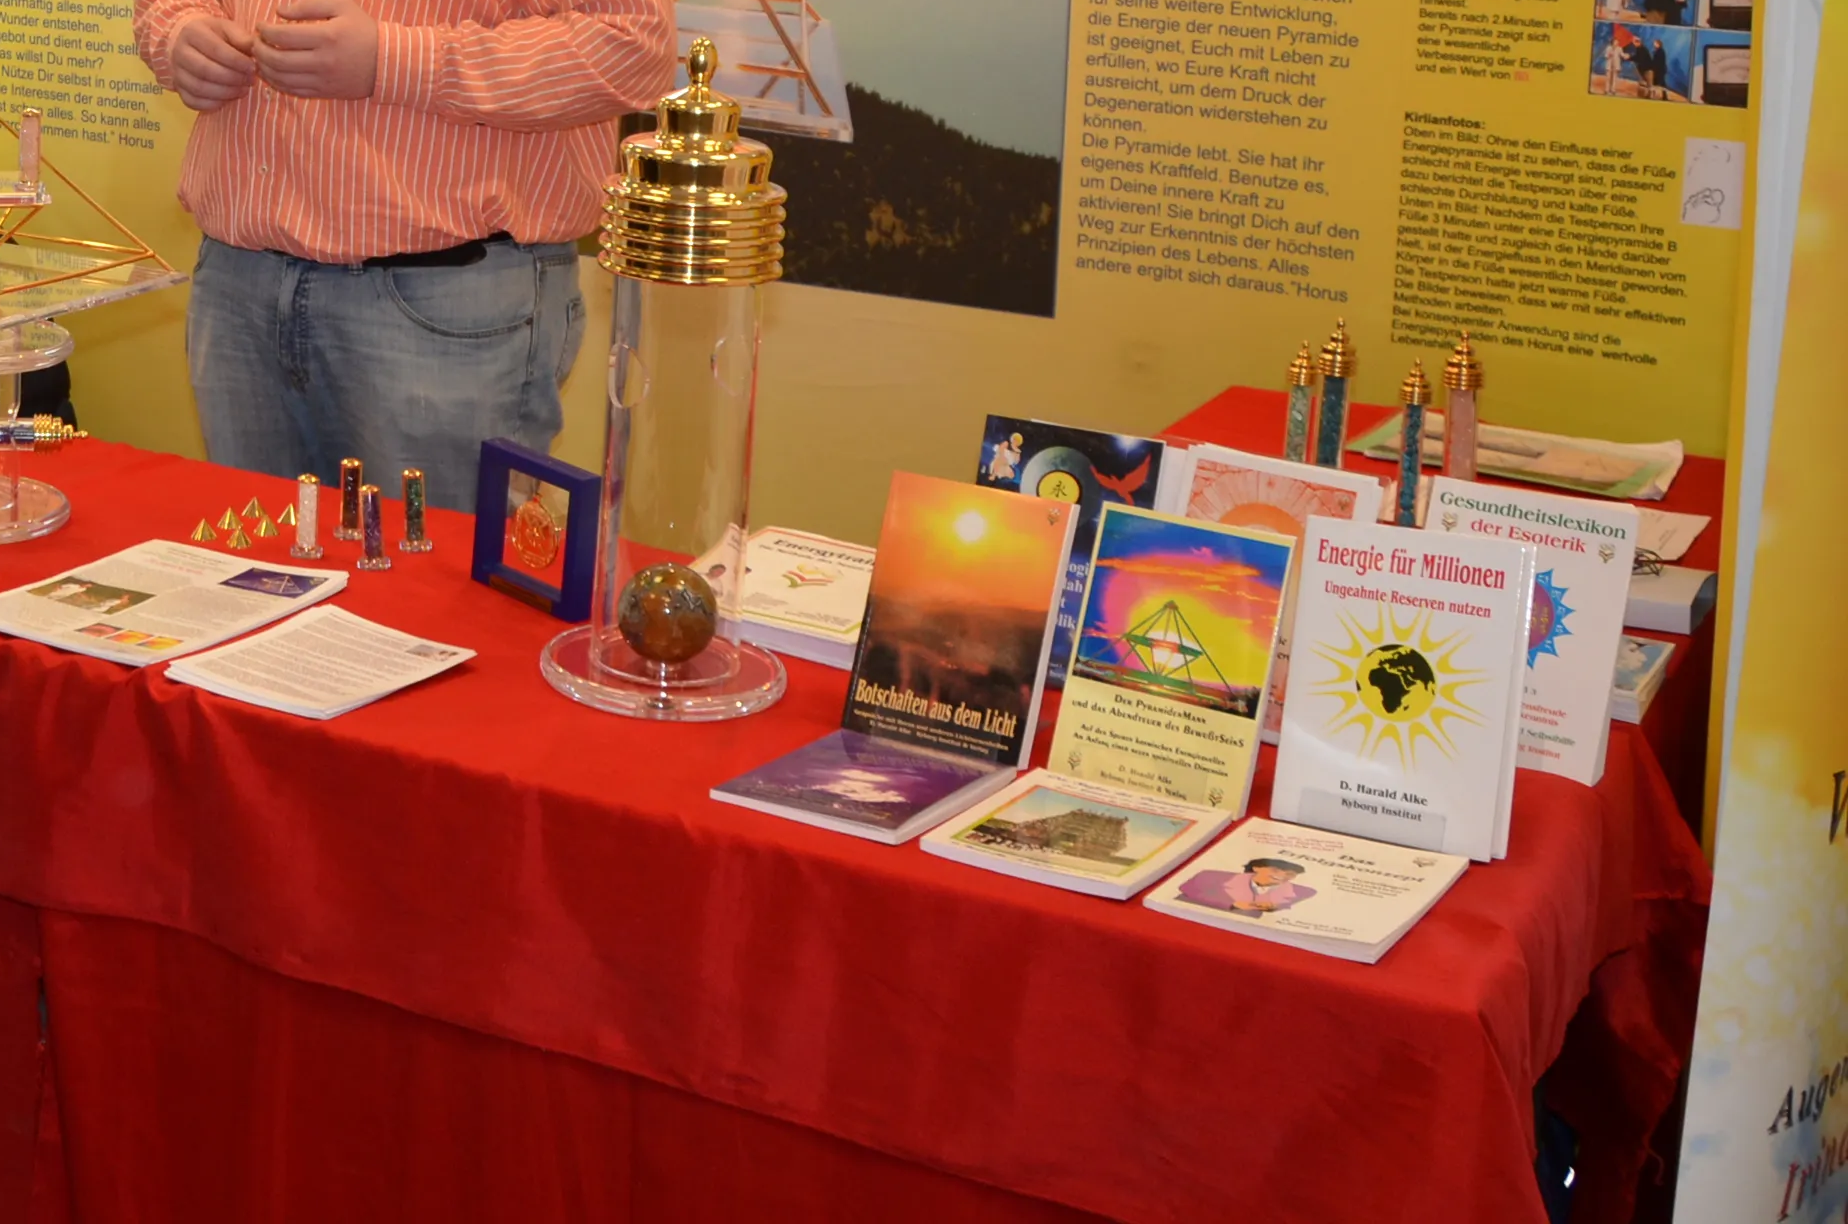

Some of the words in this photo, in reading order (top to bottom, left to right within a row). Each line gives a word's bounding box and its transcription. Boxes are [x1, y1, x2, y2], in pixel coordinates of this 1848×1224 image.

[1404, 111, 1485, 130] Kirlianfotos:
[1075, 256, 1132, 275] andere
[1136, 264, 1183, 283] ergibt
[1187, 269, 1221, 286] sich
[1440, 492, 1626, 540] Gesundheitslexikon
[1470, 518, 1503, 536] der
[1508, 525, 1585, 553] Esoterik
[1317, 538, 1384, 577] Energie
[1389, 548, 1417, 576] für
[1420, 553, 1505, 590] Millionen
[1324, 580, 1387, 603] Ungeahnte
[1390, 590, 1445, 612] Reserven
[1448, 602, 1491, 619] nutzen
[855, 680, 930, 715] Botschaften
[928, 700, 953, 723] aus
[954, 703, 982, 729] dem
[982, 708, 1017, 738] Licht
[1339, 780, 1352, 792] D.
[1356, 783, 1397, 800] Harald
[1400, 792, 1428, 806] Alke
[1341, 797, 1378, 815] Kyborg
[1381, 805, 1422, 822] Institut
